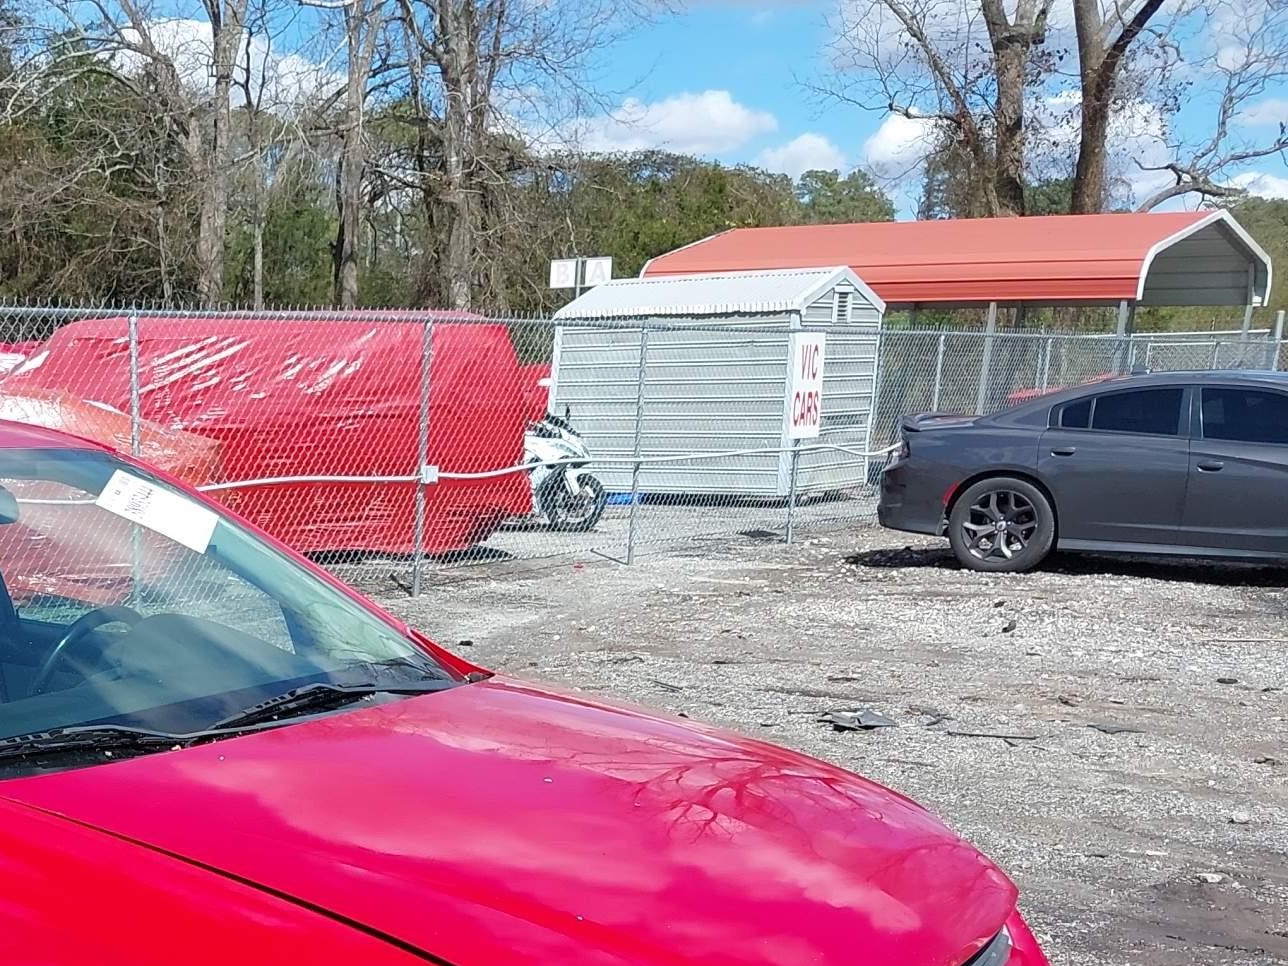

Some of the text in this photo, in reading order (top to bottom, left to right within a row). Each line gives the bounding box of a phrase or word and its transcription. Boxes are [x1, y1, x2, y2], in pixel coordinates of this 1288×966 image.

[556, 263, 570, 282] B
[588, 261, 607, 282] A
[801, 344, 819, 380] VIC
[793, 390, 819, 427] CARS
